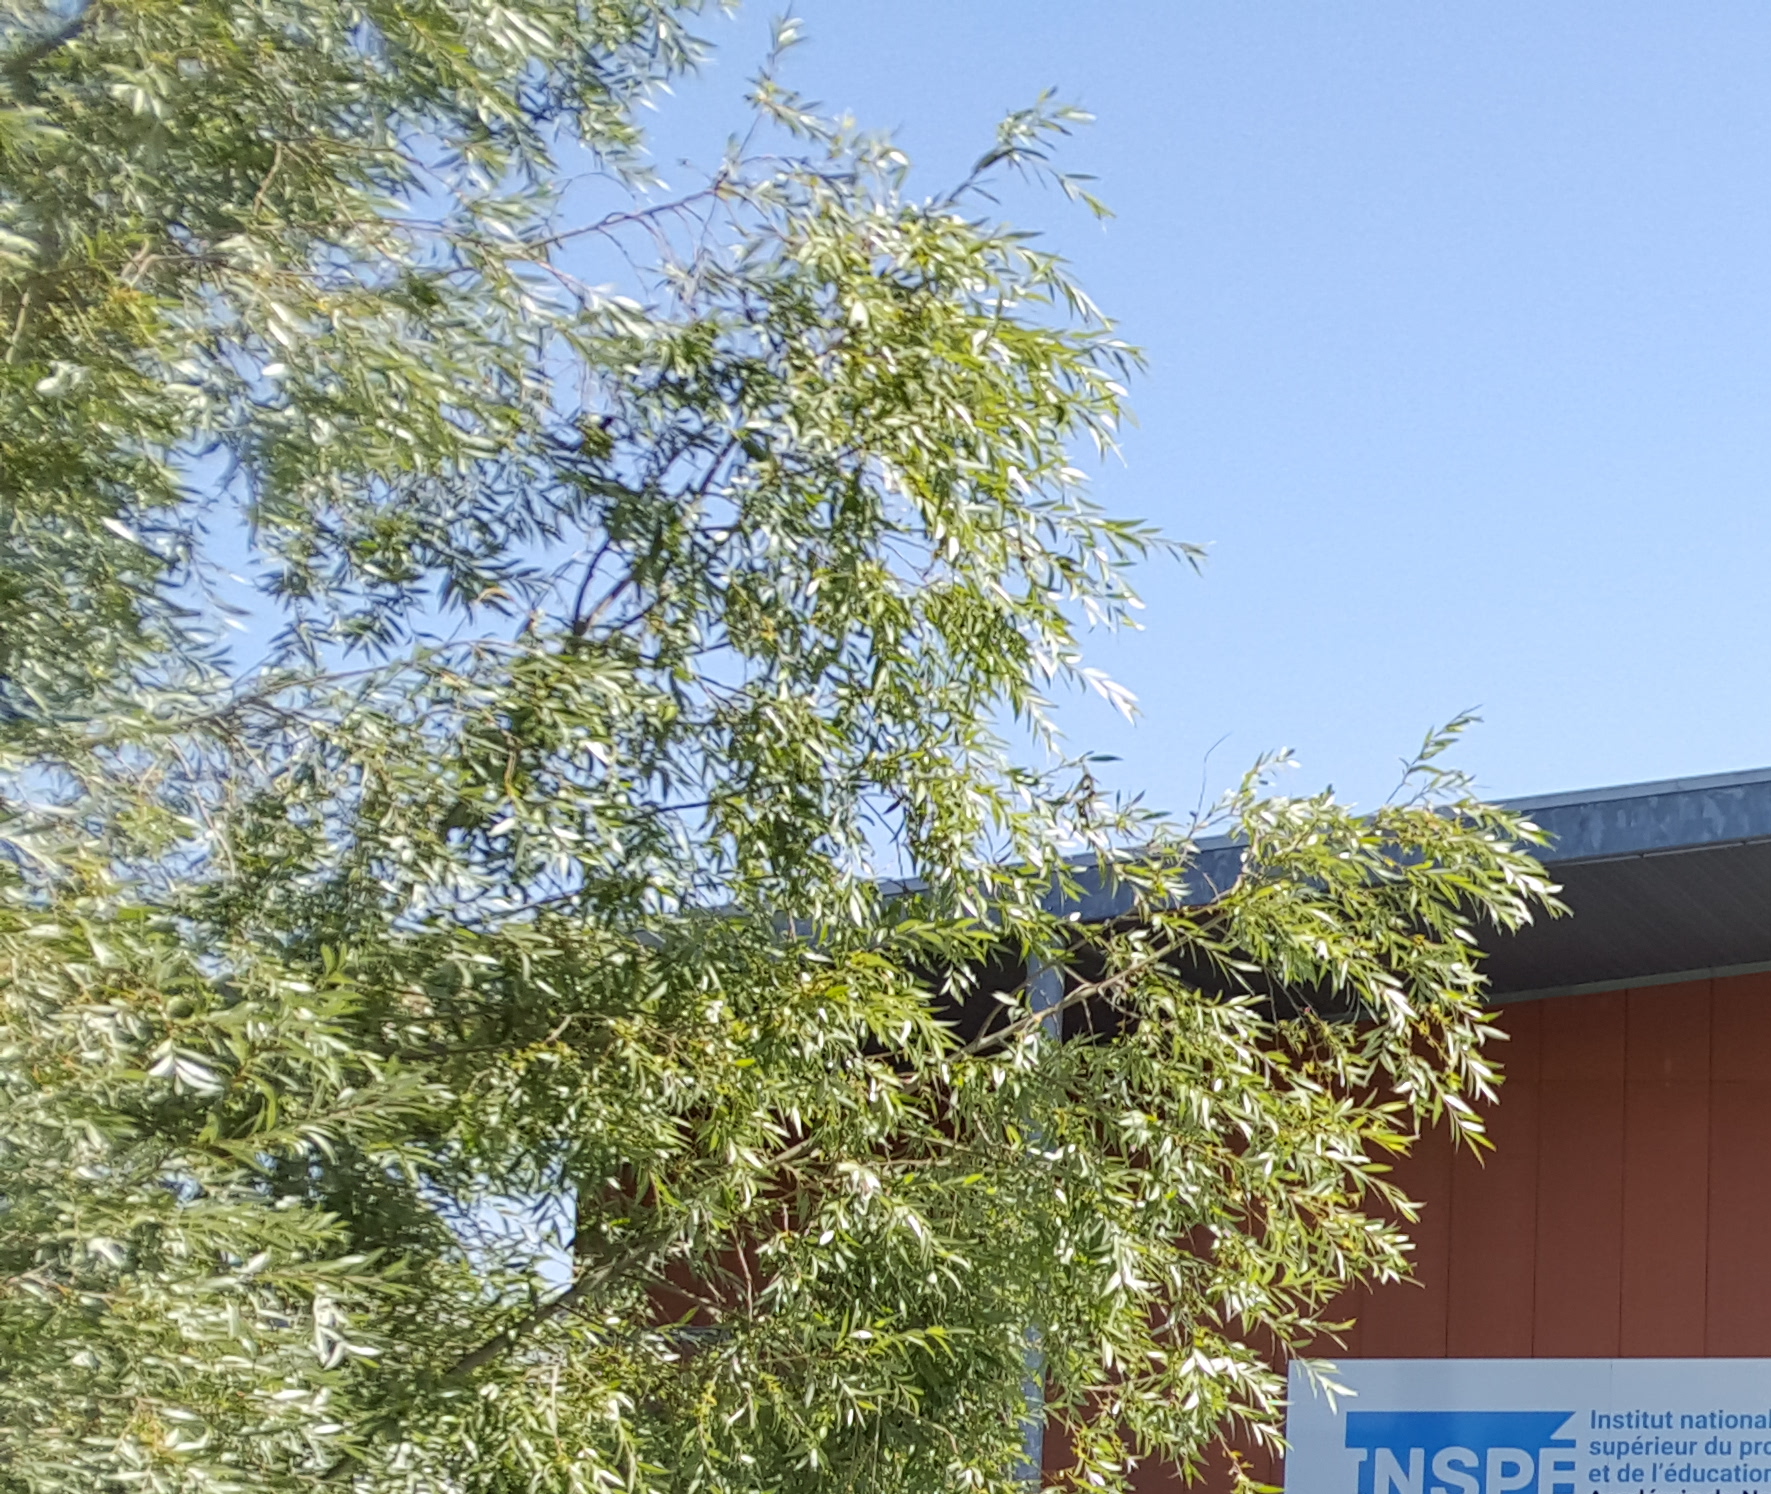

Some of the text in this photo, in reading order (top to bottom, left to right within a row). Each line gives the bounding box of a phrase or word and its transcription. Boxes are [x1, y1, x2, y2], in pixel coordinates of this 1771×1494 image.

[1590, 1409, 1674, 1430] Institut
[1588, 1435, 1698, 1460] supérieur
[1704, 1435, 1733, 1456] du
[1588, 1464, 1611, 1483] et
[1616, 1462, 1645, 1483] de
